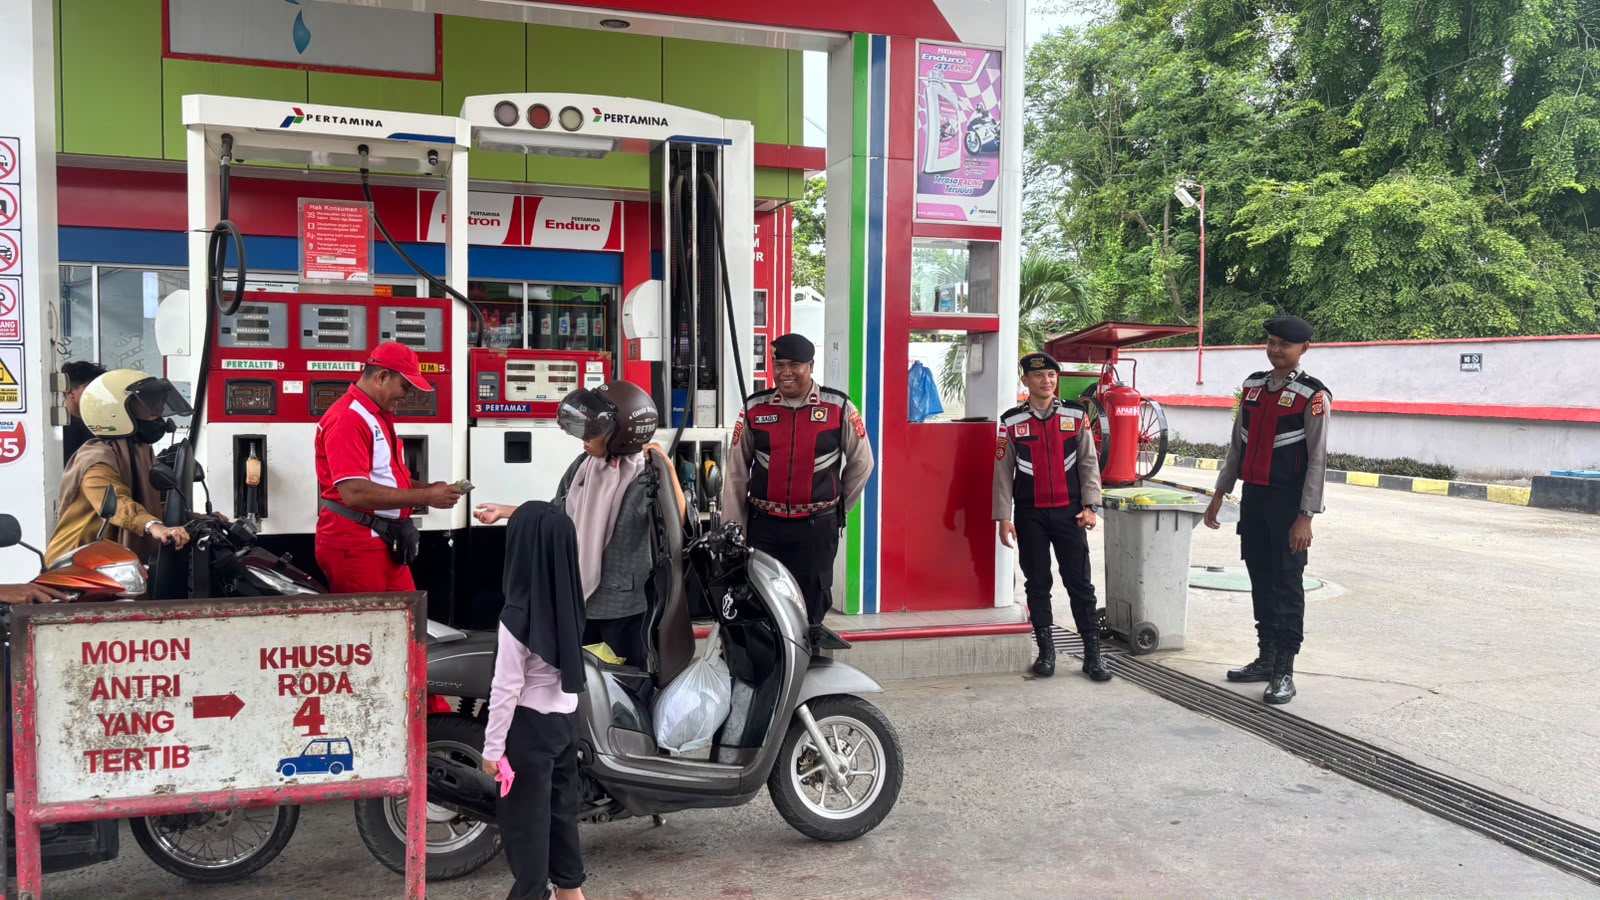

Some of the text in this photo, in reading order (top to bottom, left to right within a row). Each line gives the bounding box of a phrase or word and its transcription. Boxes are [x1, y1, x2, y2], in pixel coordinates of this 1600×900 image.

[921, 53, 964, 64] Enduro
[938, 48, 967, 56] PERTAMINA
[306, 113, 384, 128] PERTAMINA
[604, 113, 669, 127] PERTAMINA
[441, 213, 501, 227] Ftron
[545, 219, 601, 232] Enduro
[226, 361, 274, 369] PERTALITE
[311, 362, 356, 370] PERTALITE
[475, 404, 527, 413] 3 PERTAMAX
[0, 437, 20, 457] 5
[81, 637, 191, 666] MOHON
[259, 643, 373, 670] KHUSUS
[90, 674, 181, 701] ANTRI
[278, 671, 354, 697] RODA
[97, 710, 175, 737] YANG
[293, 696, 328, 737] 4
[83, 745, 190, 774] TERTIB
